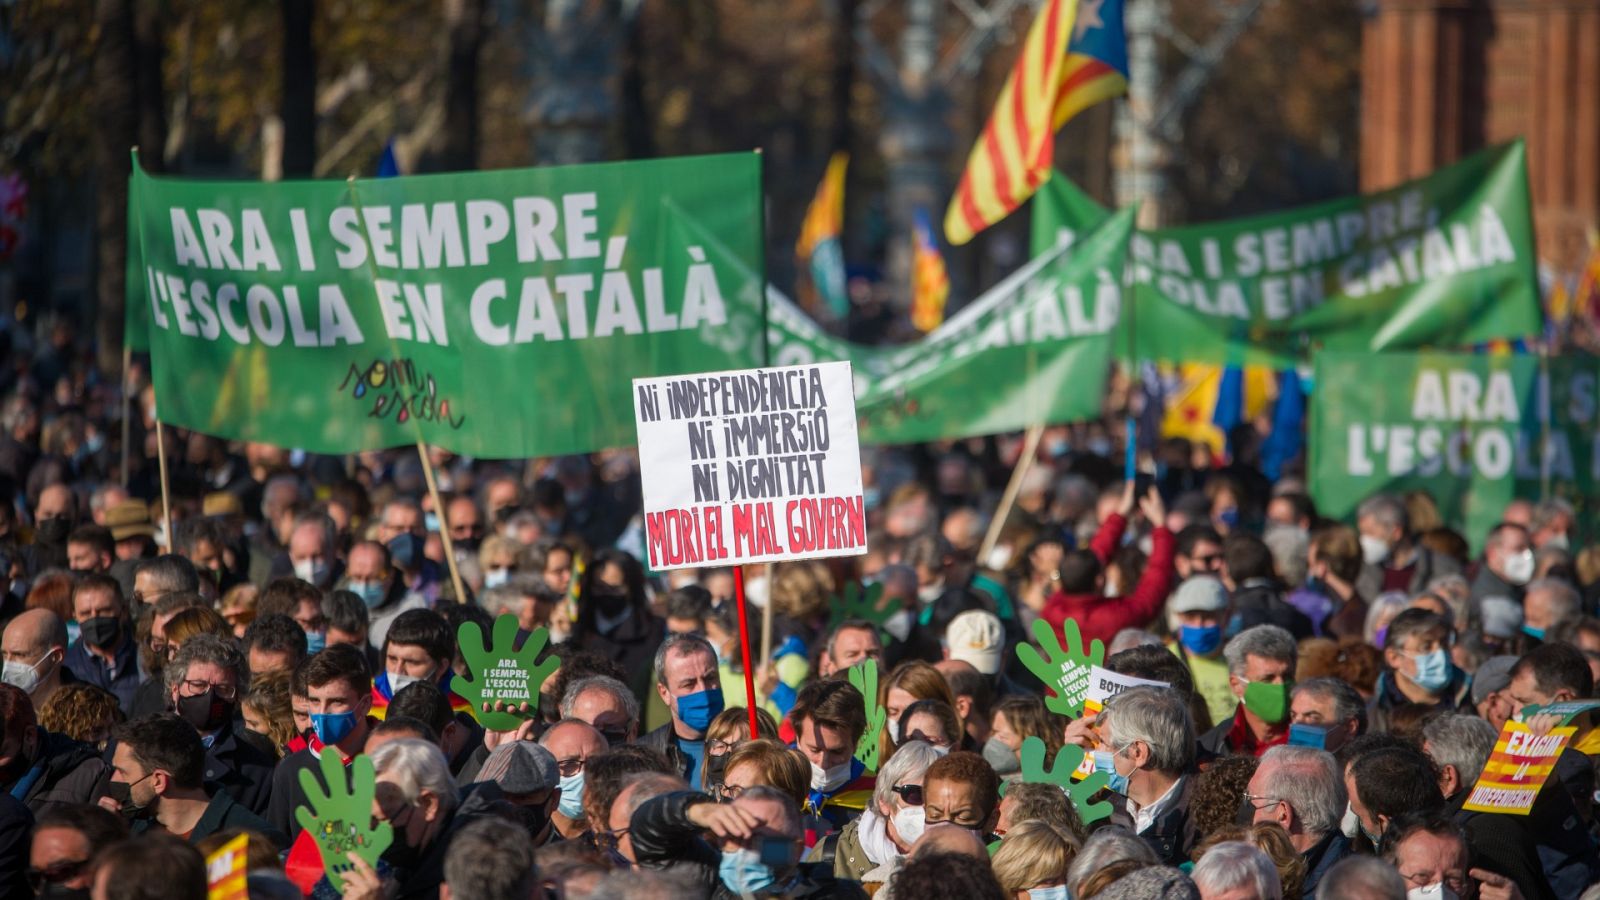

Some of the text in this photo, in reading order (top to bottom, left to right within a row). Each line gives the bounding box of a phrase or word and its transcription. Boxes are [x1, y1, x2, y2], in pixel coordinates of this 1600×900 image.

[169, 207, 282, 271] ARA
[290, 208, 315, 271] I
[147, 265, 364, 347] L'ESCOLA
[375, 279, 449, 347] EN
[1412, 369, 1520, 422] ARA
[1347, 424, 1575, 480] L'ESCOLA
[703, 505, 728, 561] EL
[732, 502, 783, 558] MAL
[785, 495, 866, 553] GOVERN
[483, 669, 530, 680] I SEMPRE,
[498, 659, 517, 668] ARA
[1060, 659, 1076, 673] ARA
[481, 689, 494, 698] EN
[485, 679, 527, 688] L'ESCOLA
